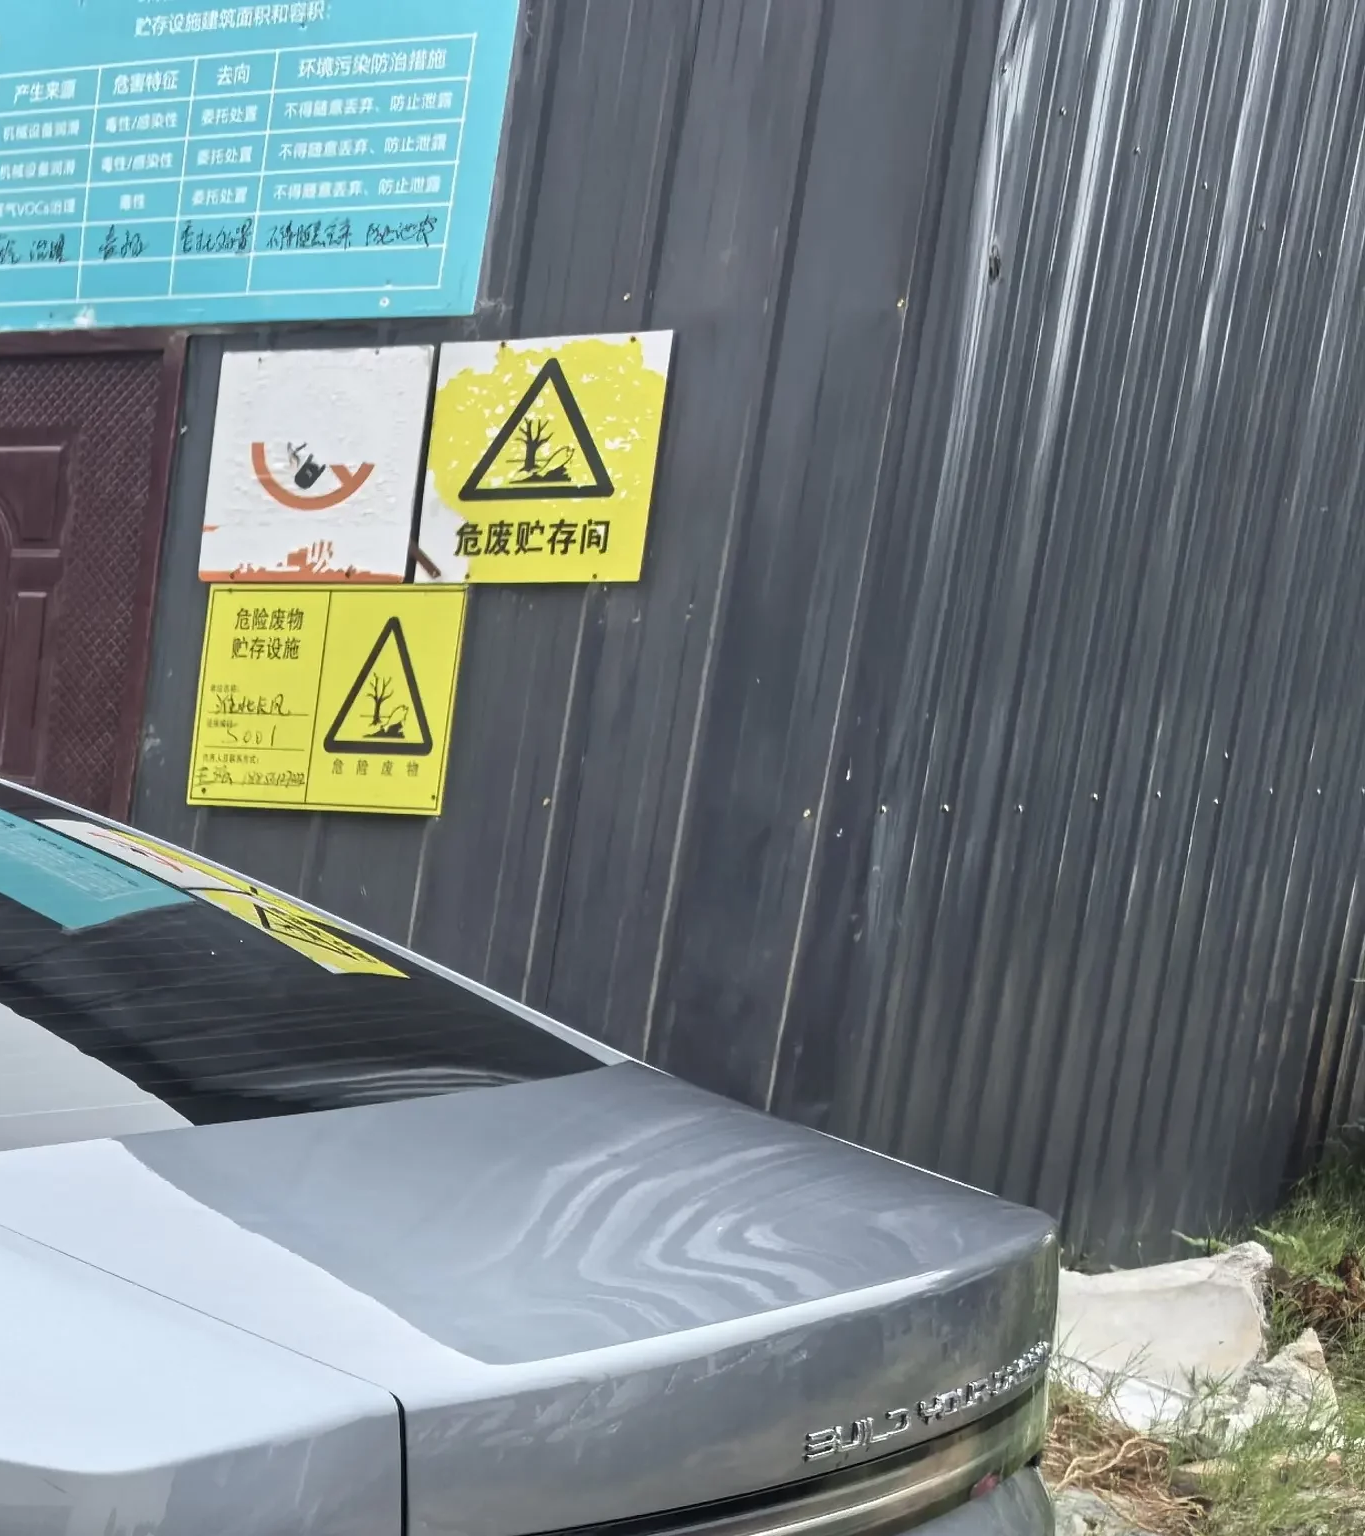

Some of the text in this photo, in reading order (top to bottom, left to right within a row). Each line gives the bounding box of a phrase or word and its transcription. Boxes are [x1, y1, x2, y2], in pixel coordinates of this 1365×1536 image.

[217, 63, 250, 86] 去向
[298, 48, 447, 80] 环境污染防治措施
[14, 79, 76, 105] 产生来源
[113, 70, 179, 96] 危害特征
[105, 111, 178, 133] 毒性/感染性
[201, 105, 258, 126] 委托处置
[101, 152, 173, 173] 毒性/感染性
[197, 146, 252, 166] 委托处置
[192, 187, 248, 206] 委托处置
[453, 518, 610, 556] 危废贮存间
[235, 608, 304, 631] 危险废物
[231, 636, 301, 659] 贮存设施
[331, 760, 419, 777] 危险废物
[803, 1408, 912, 1462] BUILD
